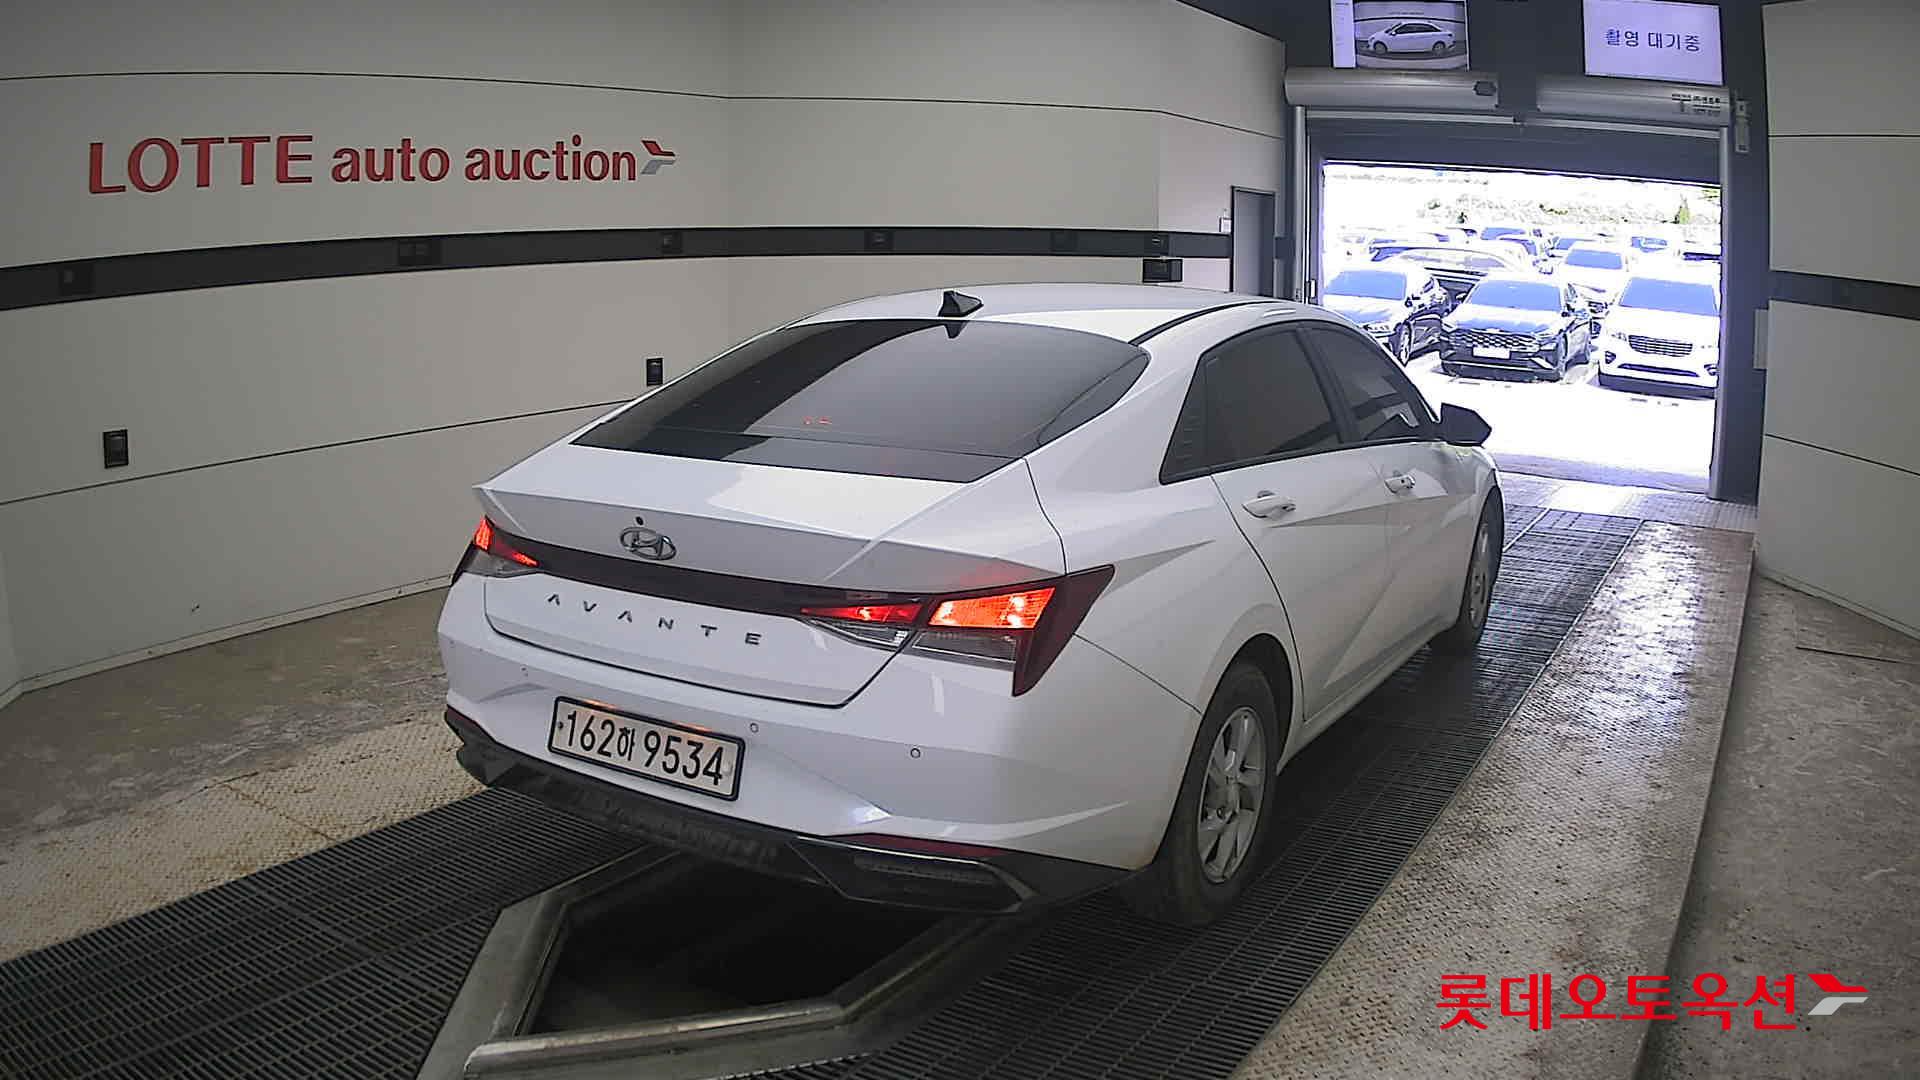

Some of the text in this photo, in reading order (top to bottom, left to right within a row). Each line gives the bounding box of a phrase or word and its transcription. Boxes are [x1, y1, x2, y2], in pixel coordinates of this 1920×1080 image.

[1648, 32, 1700, 52] 대기중
[89, 134, 637, 194] LOTTE auto auction
[547, 594, 762, 646] AVANTE
